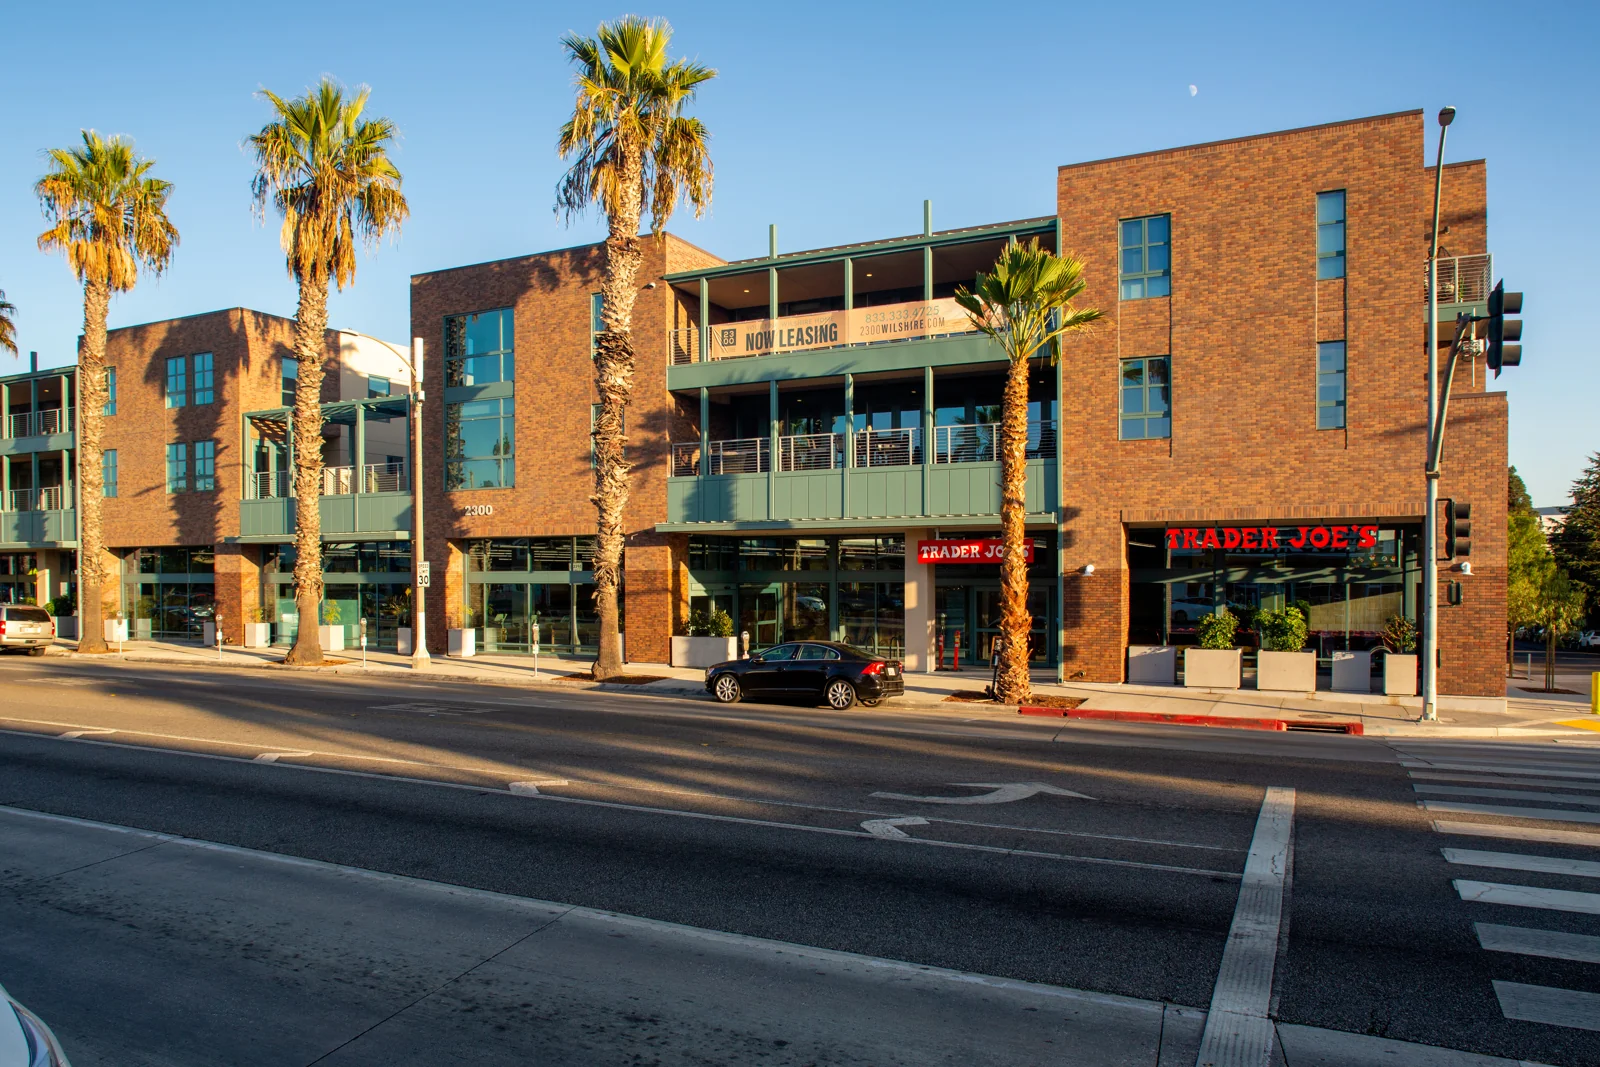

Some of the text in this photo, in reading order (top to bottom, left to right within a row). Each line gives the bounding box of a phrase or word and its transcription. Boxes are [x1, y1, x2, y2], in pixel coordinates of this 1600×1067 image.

[865, 305, 940, 323] 833.333.4725
[860, 317, 945, 336] 2300WILSHIRE.COM
[745, 323, 838, 351] NOW LEASING
[465, 505, 493, 516] 2300
[1165, 525, 1379, 549] TRADER JOE'S
[920, 545, 981, 558] TRADER
[418, 575, 429, 585] 30
